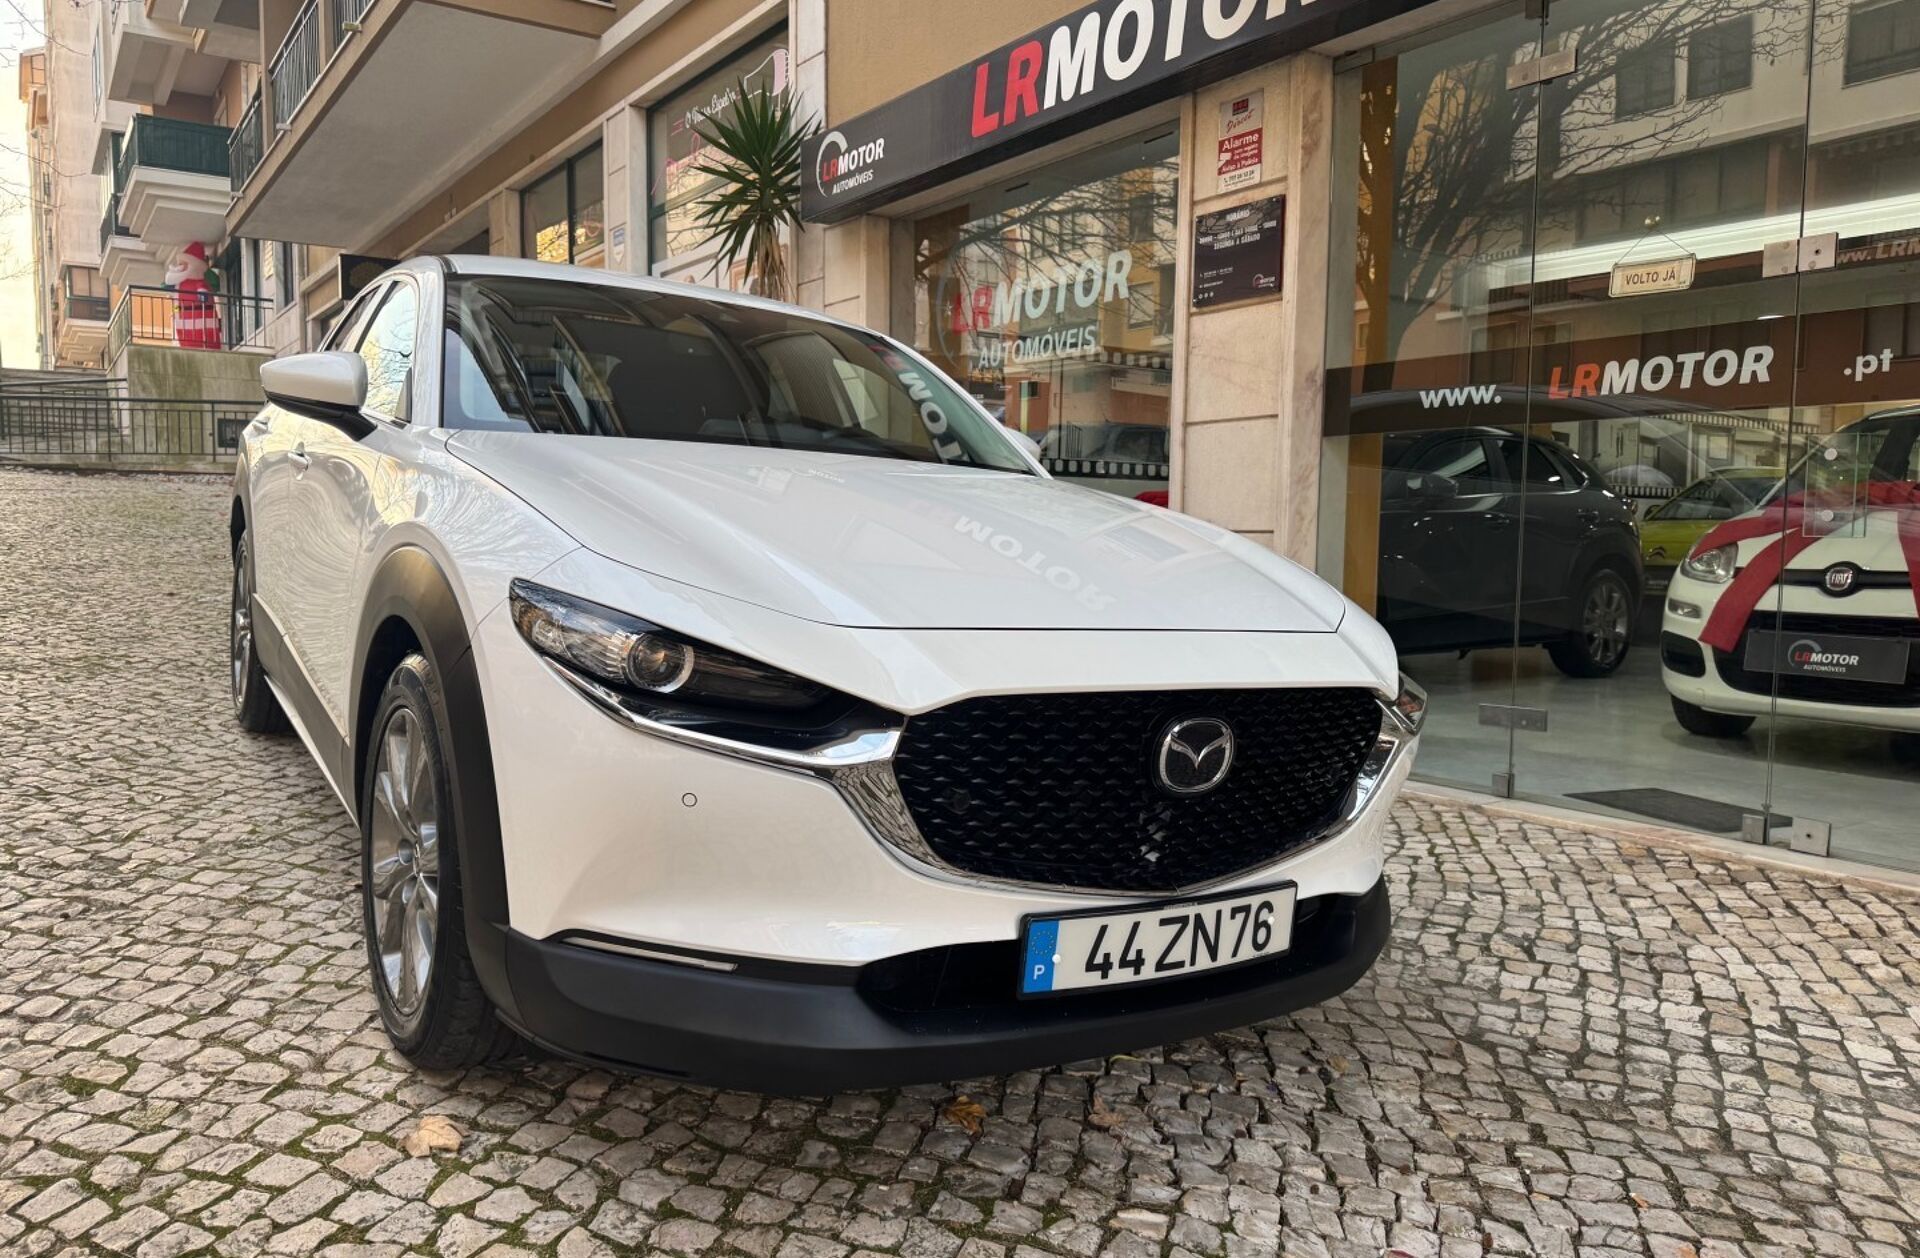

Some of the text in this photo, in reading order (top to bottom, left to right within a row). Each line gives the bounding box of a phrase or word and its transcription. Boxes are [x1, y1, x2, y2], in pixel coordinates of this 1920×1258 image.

[971, 0, 1320, 138] LRMOTO
[1222, 133, 1260, 152] Alarme
[822, 137, 885, 182] LRMOTOR
[832, 169, 874, 195] AUTOMÓVEIS
[1625, 271, 1660, 285] VOLTO
[1662, 266, 1676, 282] JÁ
[953, 250, 1133, 336] LRMOTOR
[978, 326, 1097, 369] AUTOMÓVEIS
[1420, 345, 1894, 409] www. LRMOTOR .pt
[1830, 572, 1850, 585] FIAT
[1794, 651, 1860, 666] LRMOTOR
[1033, 964, 1045, 980] P
